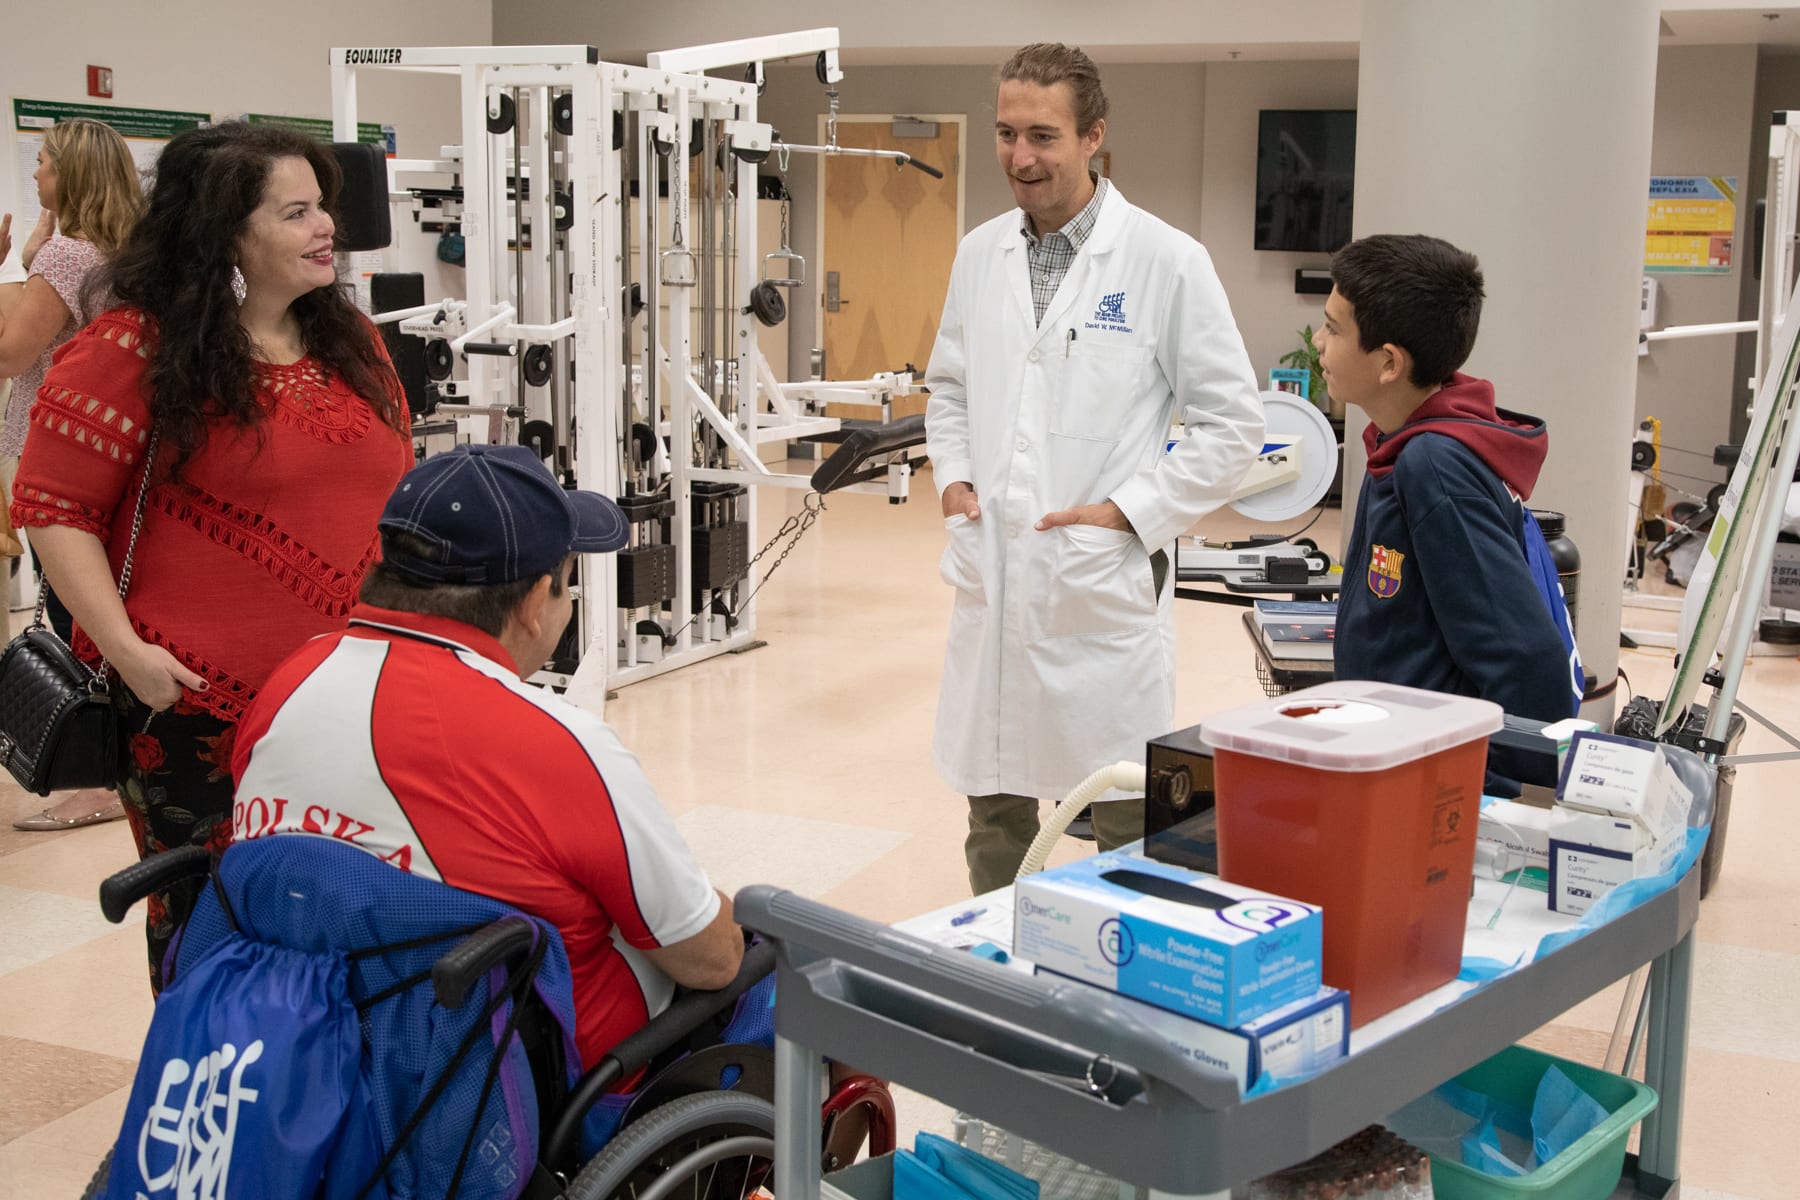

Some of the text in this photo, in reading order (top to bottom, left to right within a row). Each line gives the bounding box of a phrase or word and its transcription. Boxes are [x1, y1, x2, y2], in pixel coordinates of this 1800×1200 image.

[345, 48, 402, 64] EQUALIZER
[231, 796, 412, 874] POLSKA
[1138, 943, 1225, 980] Nitrile Examination
[1192, 975, 1224, 996] Gloves
[1194, 1049, 1229, 1070] Gloves
